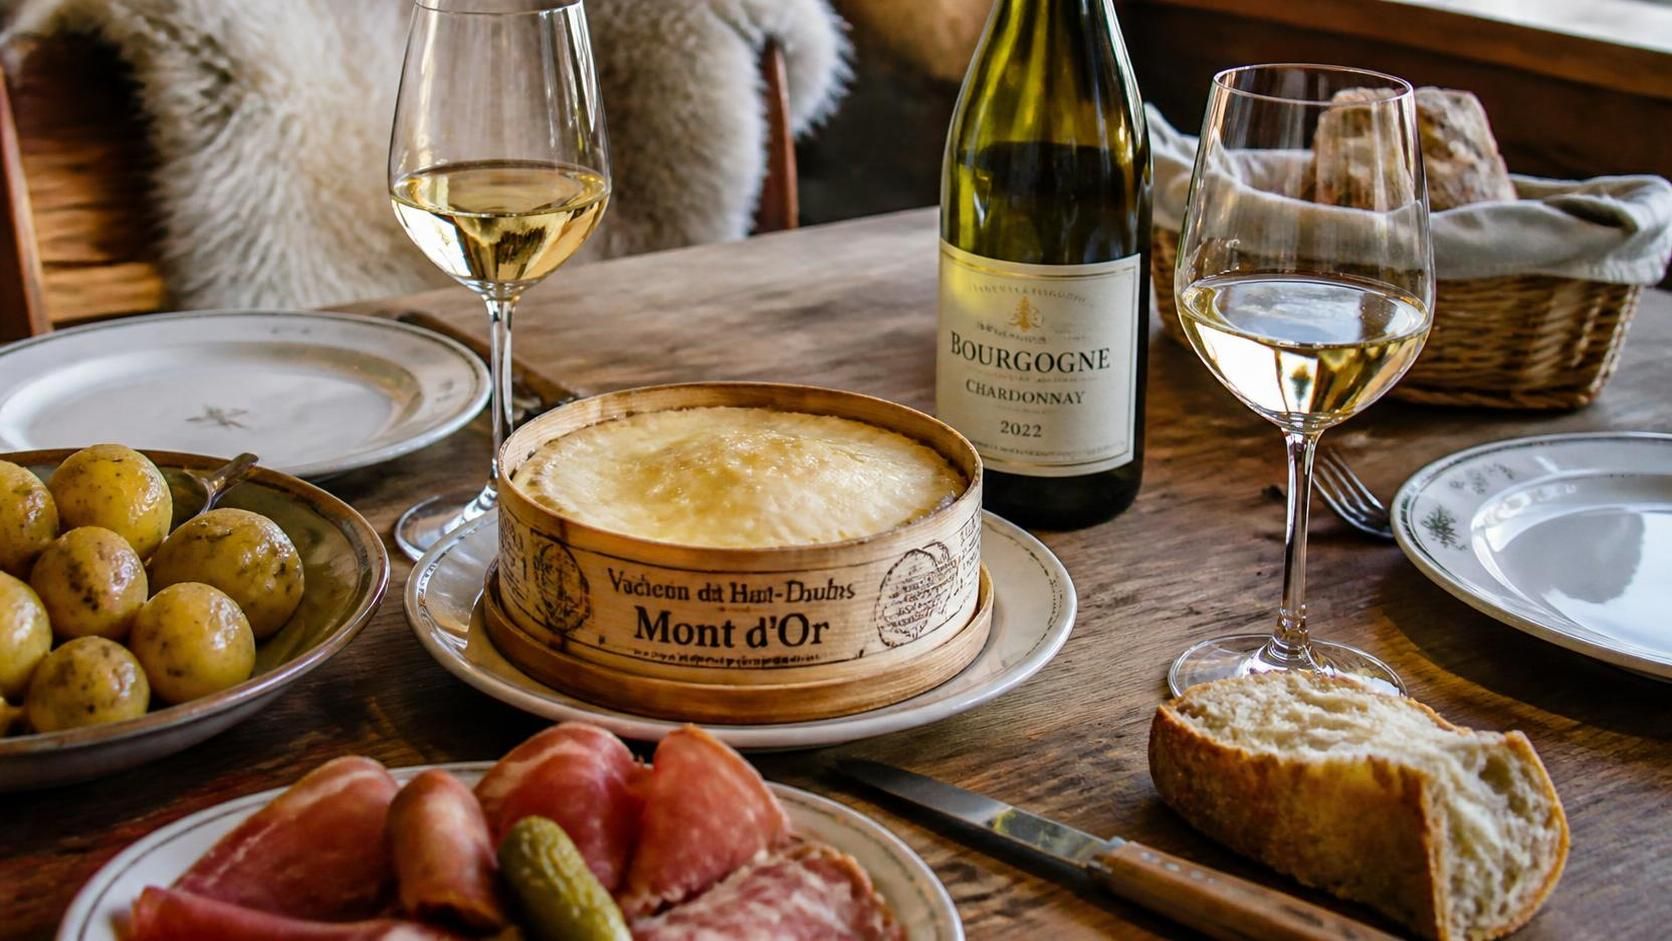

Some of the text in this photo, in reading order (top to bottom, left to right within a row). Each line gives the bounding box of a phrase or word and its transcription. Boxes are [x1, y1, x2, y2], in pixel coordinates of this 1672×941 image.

[951, 330, 1110, 373] BOURGOGNE
[965, 378, 1086, 404] CHARDONNAY
[1000, 420, 1042, 437] 2022
[634, 605, 829, 648] Mont d'Or
